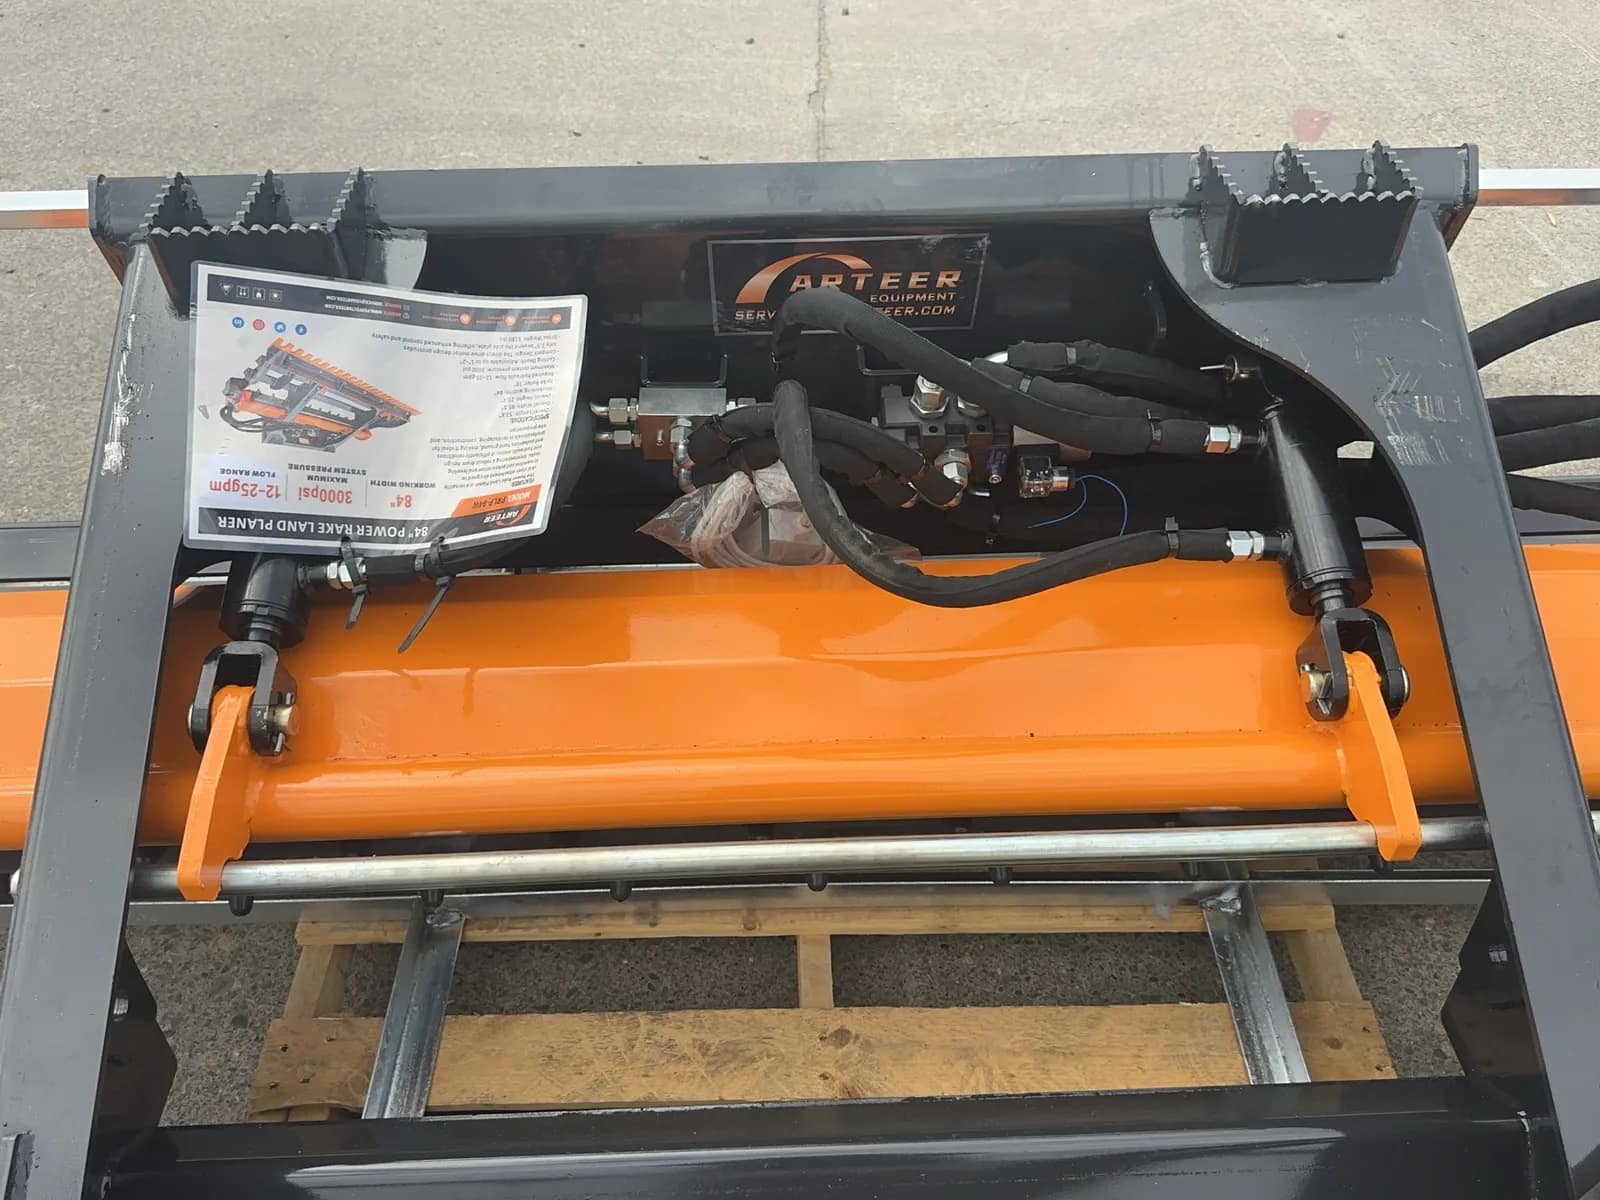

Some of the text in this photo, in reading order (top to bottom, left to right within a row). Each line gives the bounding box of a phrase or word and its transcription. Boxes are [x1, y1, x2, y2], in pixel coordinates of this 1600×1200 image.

[789, 270, 961, 292] ARTEER
[870, 292, 956, 303] EQUIPMENT
[220, 468, 276, 478] FLOW RANGE
[288, 463, 367, 476] SYSTEM PRESSURE
[307, 475, 348, 484] MAXIMUM
[370, 480, 435, 489] WORKING WIDTH
[209, 478, 281, 499] 12-25gpm
[298, 486, 353, 504] 3000psi
[390, 494, 412, 508] 84"
[484, 510, 519, 523] ARTEER
[218, 516, 428, 538] 84" POWER RAKE LAND PLANER
